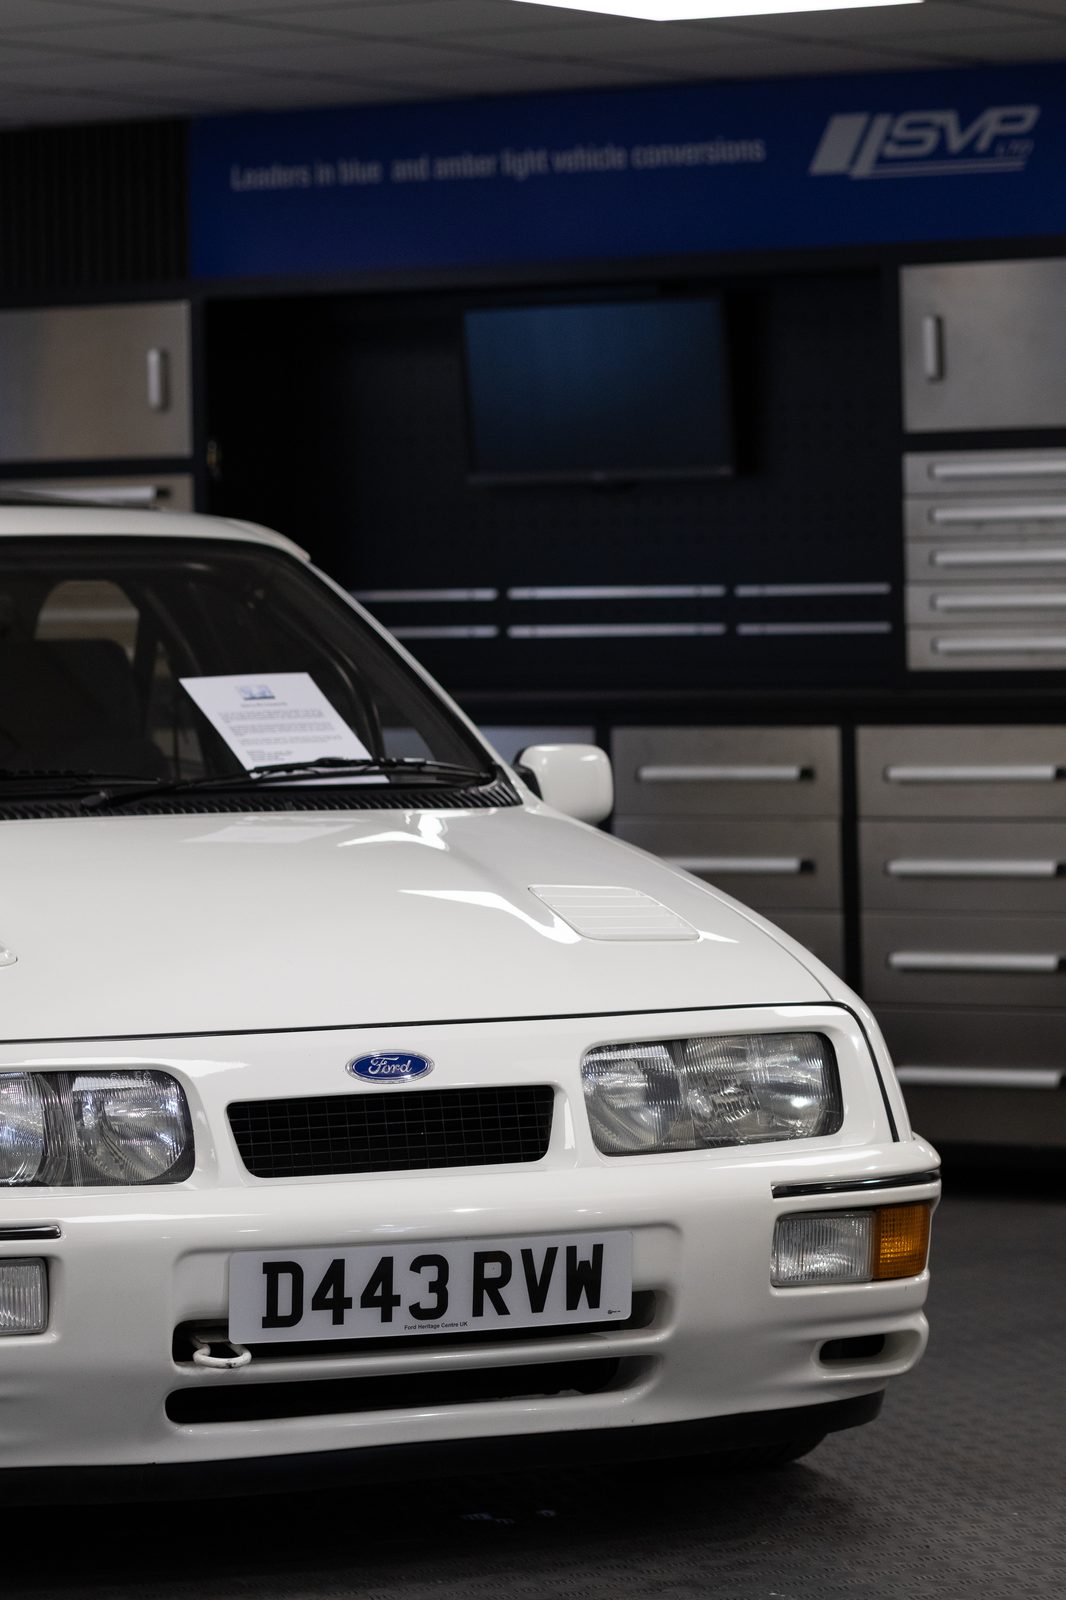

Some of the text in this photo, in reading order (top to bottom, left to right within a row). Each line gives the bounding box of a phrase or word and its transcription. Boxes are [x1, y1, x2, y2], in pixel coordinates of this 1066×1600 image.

[881, 105, 1040, 158] SVP
[231, 136, 765, 191] Leaders in blue and amber light vehicle conversions
[368, 1056, 413, 1075] Ford
[261, 1243, 604, 1328] D443 RVW
